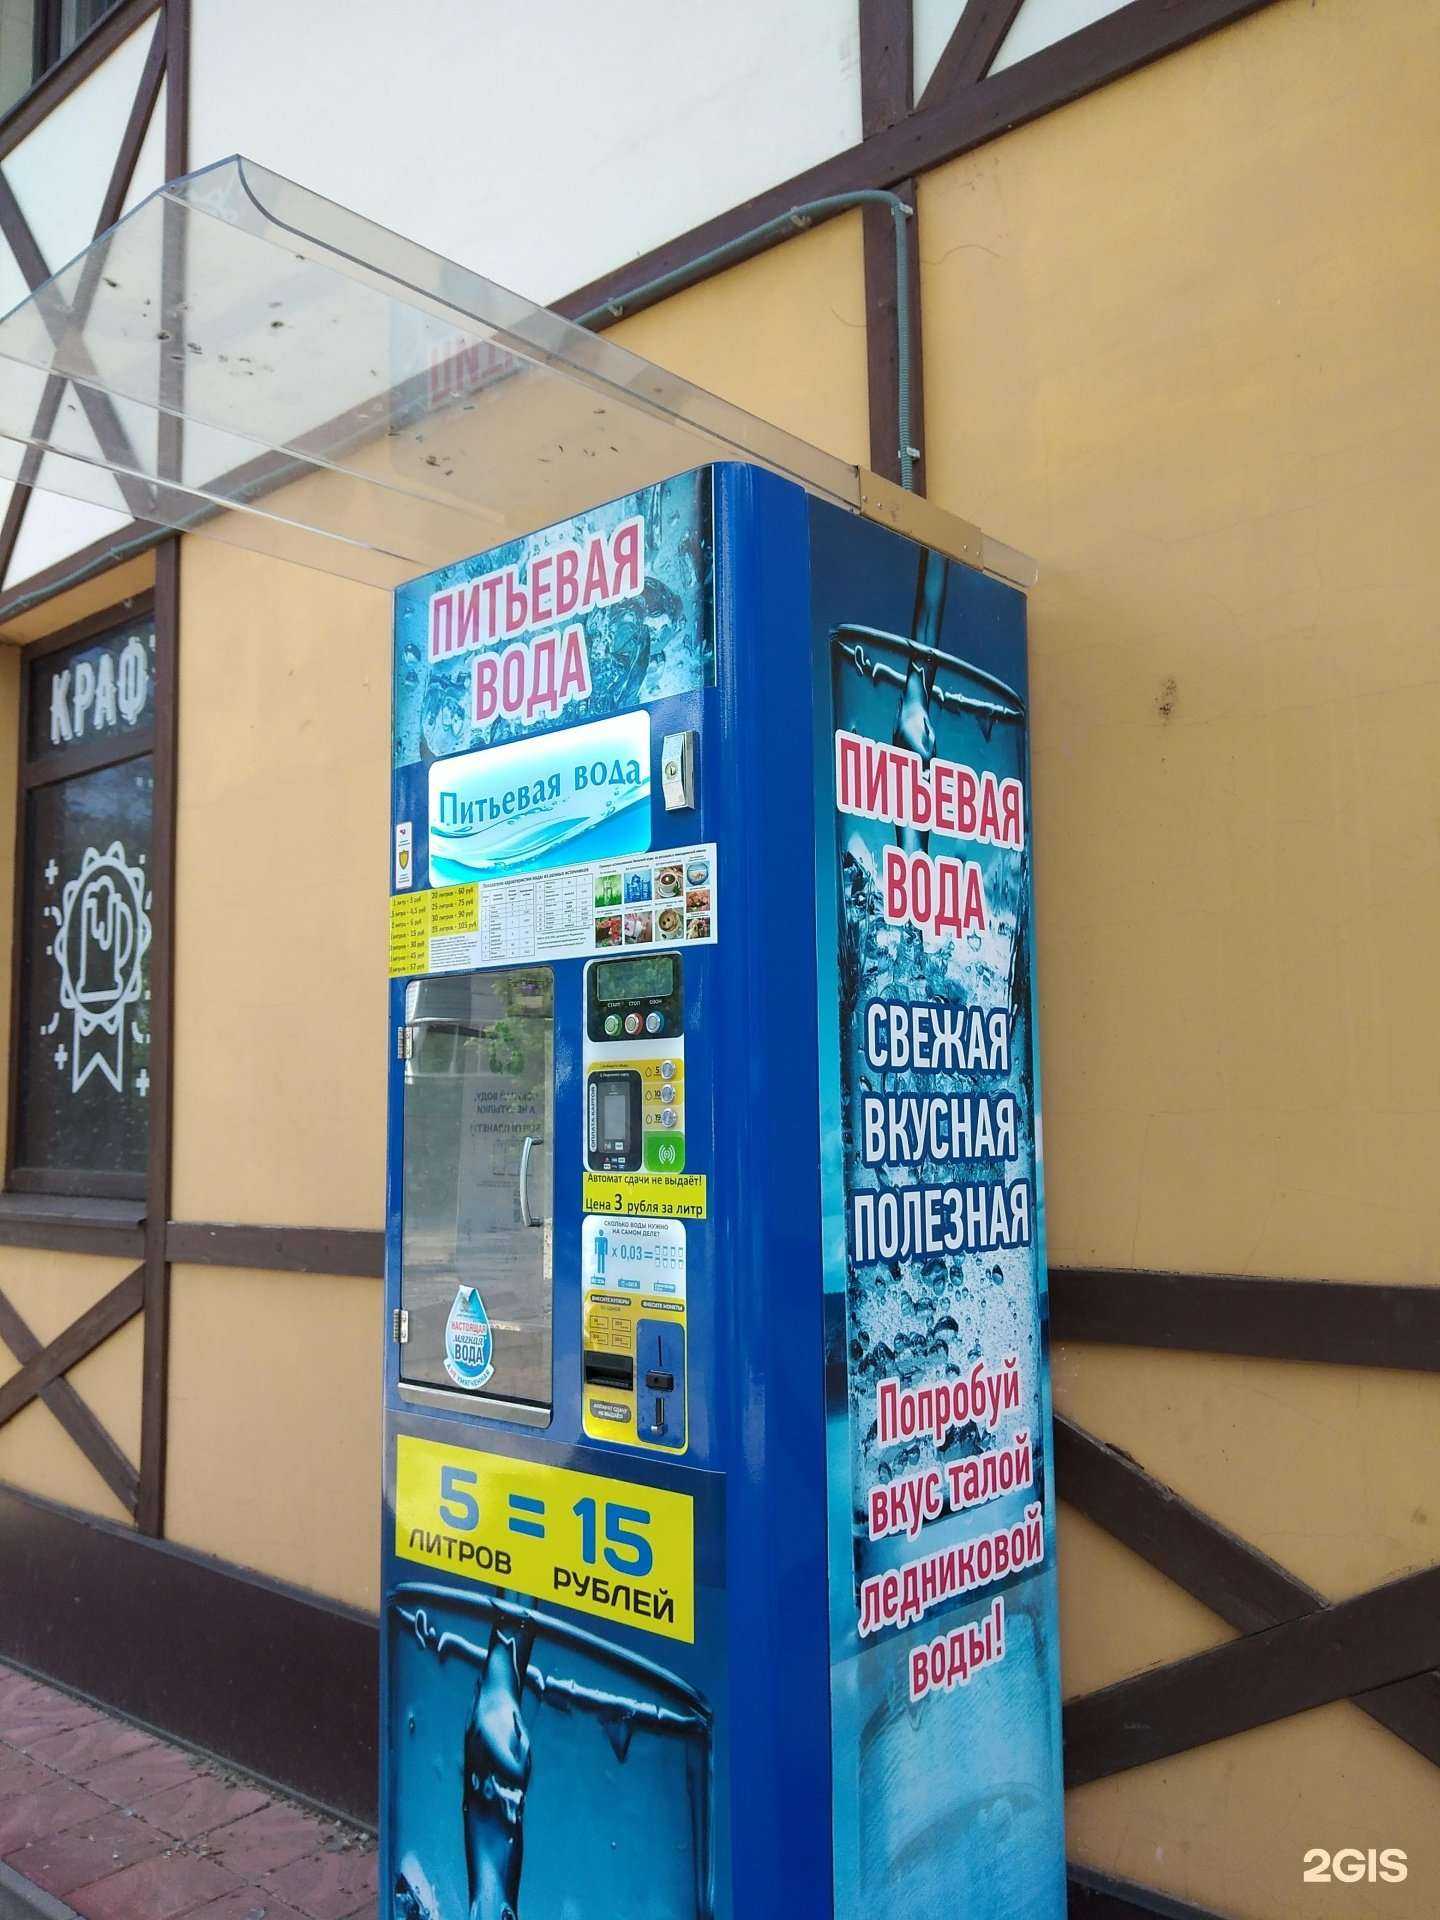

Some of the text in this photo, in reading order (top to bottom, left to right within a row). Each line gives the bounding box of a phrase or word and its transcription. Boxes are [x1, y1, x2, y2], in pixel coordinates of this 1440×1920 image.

[432, 524, 638, 656] ПИТЬЕВАЯ
[50, 634, 156, 745] КРАФ
[476, 631, 587, 721] ВОДА
[440, 759, 641, 824] Питьевая вода
[840, 738, 1020, 844] ПИТЬЕВАЯ
[887, 852, 985, 938] ВОДА
[655, 1066, 660, 1074] 5
[867, 1003, 1008, 1070] СВЕЖАЯ
[654, 1090, 661, 1098] 10
[864, 1098, 1016, 1162] ВКУСНАЯ
[585, 1193, 703, 1216] Цена 3 рубля за литр
[587, 1173, 702, 1187] Автомат сдачи не выдаёт!
[854, 1183, 1029, 1262] ПОЛЕЗНАЯ
[455, 1344, 483, 1364] ВОДА
[880, 1358, 1020, 1442] Попробуй
[439, 1465, 653, 1577] 5 = 15
[872, 1432, 1030, 1536] вкус талой
[409, 1528, 675, 1624] ЛИТРОВ РУБЛЕЙ
[862, 1506, 1041, 1630] ледниковой
[913, 1603, 1003, 1696] воды!
